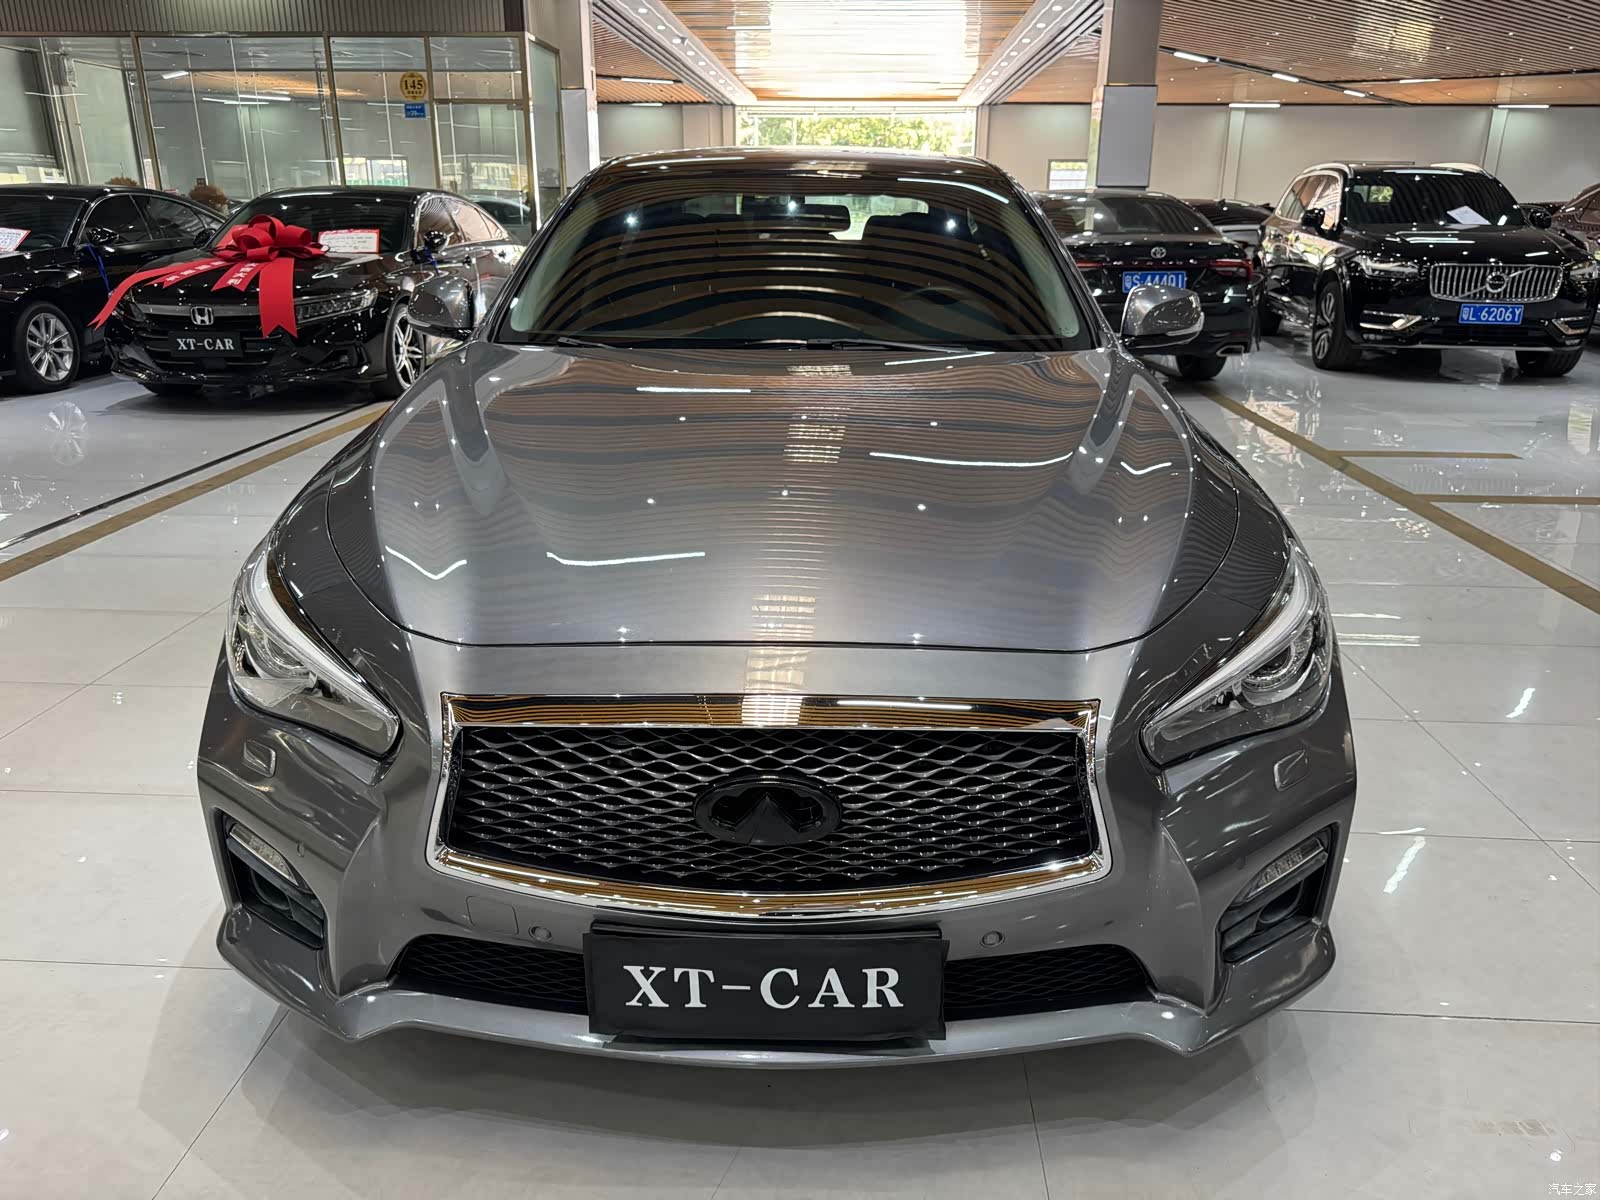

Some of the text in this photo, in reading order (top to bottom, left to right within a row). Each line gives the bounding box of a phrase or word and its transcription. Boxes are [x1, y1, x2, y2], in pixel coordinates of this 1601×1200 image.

[404, 80, 423, 90] 145
[176, 338, 235, 351] XT-CAR
[622, 965, 904, 1009] XT-CAR
